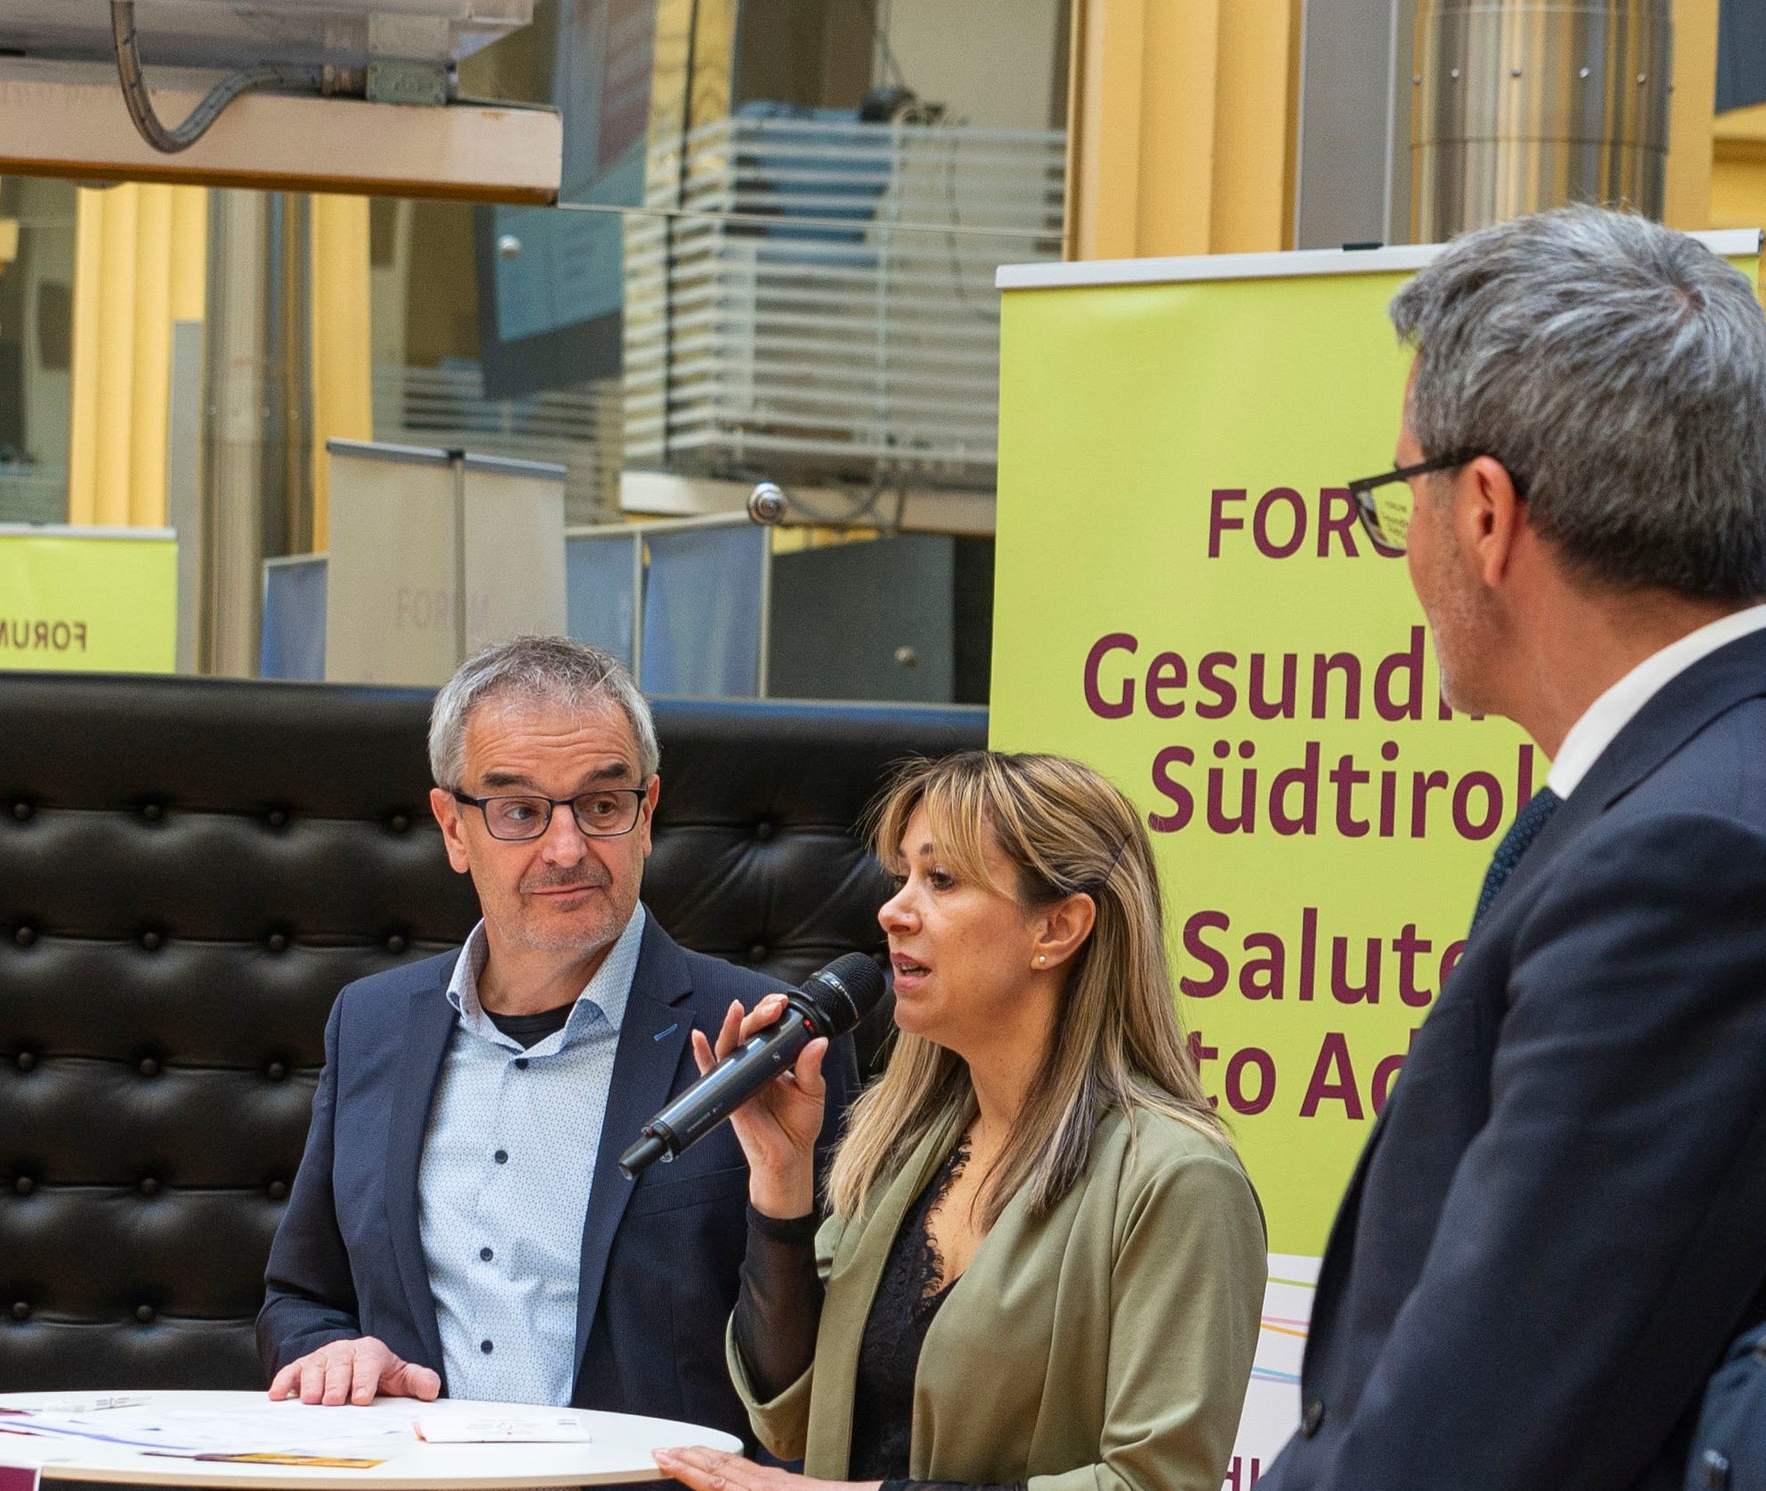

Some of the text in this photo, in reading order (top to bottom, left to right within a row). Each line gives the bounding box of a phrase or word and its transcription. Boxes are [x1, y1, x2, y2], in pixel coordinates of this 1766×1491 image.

[1207, 487, 1408, 559] FOR
[1083, 626, 1483, 721] Gesund
[1148, 740, 1534, 841] Südtirol
